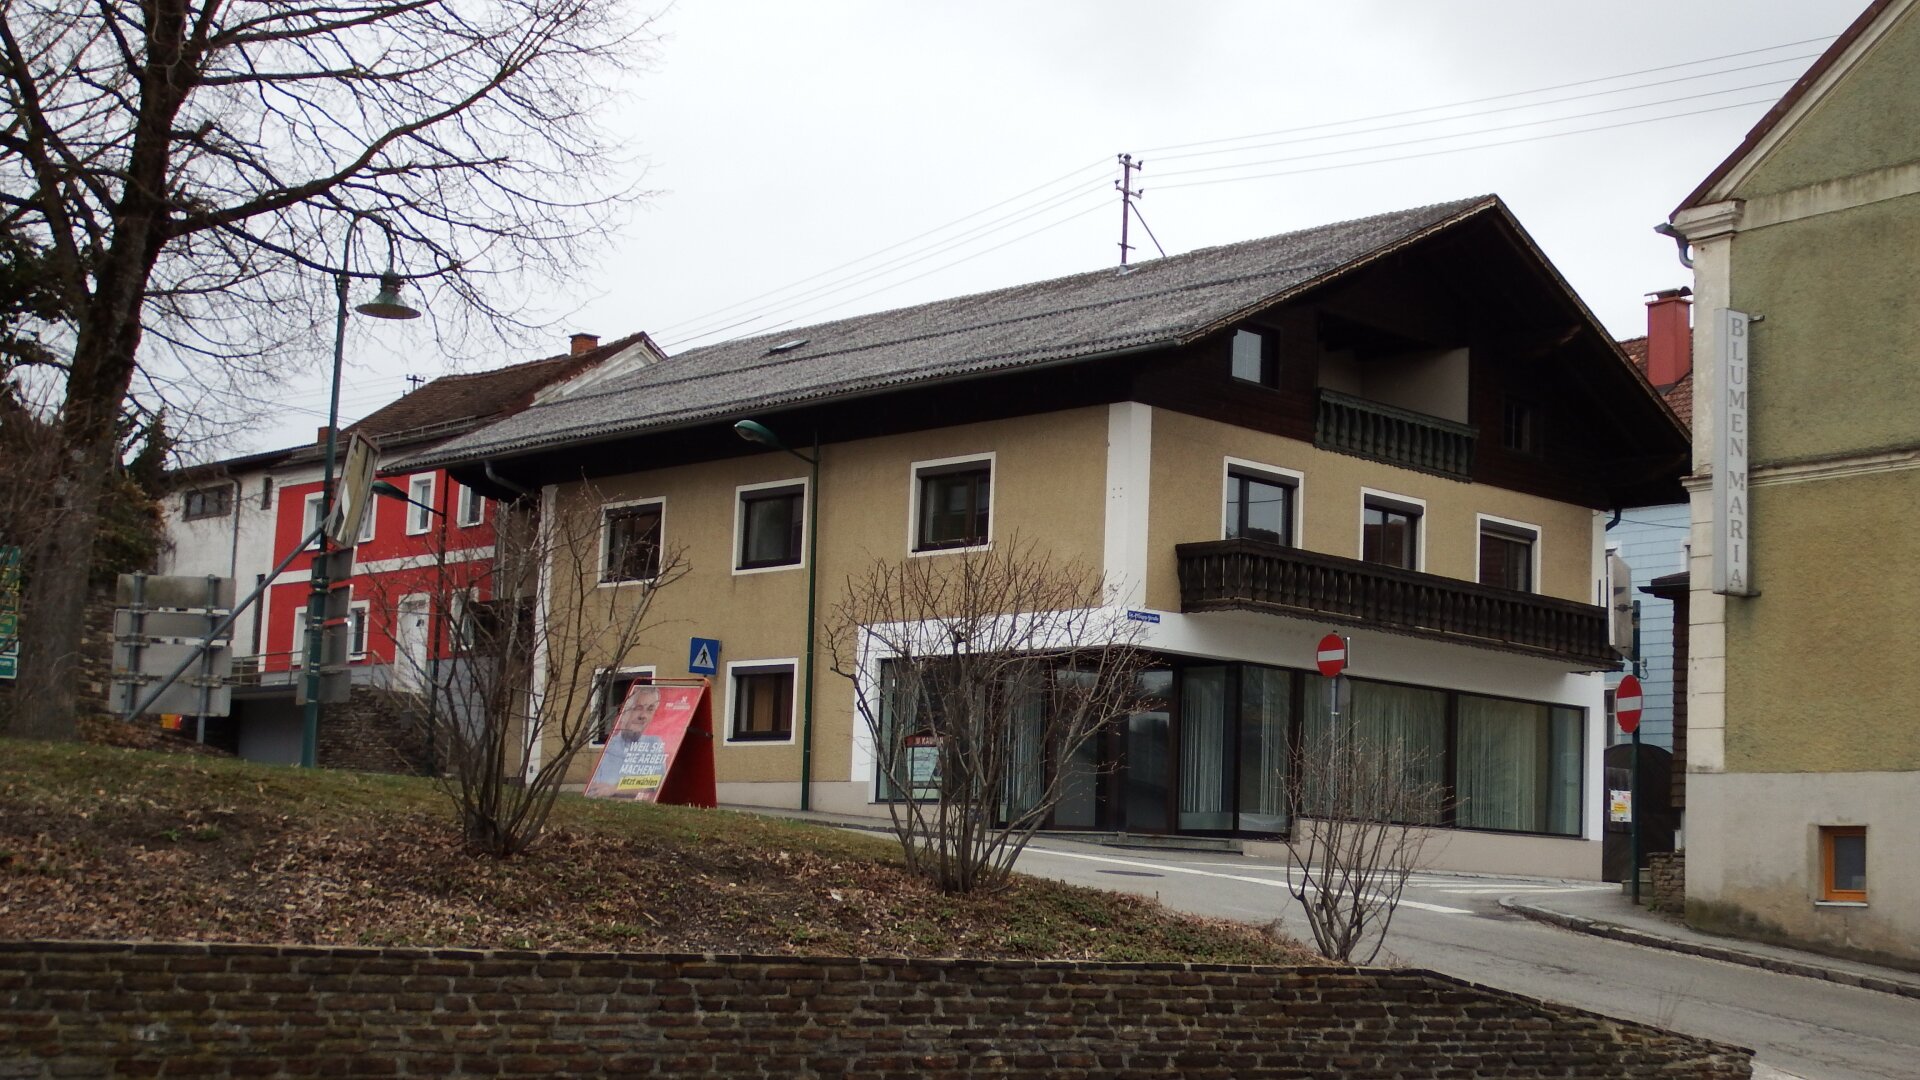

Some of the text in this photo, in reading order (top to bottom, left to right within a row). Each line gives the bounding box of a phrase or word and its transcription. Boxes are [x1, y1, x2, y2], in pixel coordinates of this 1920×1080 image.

[1728, 317, 1746, 588] BLUMEN MARIA
[650, 742, 665, 752] SIE
[624, 753, 669, 764] DIE ARBEIT
[620, 777, 658, 786] jetzt wählen
